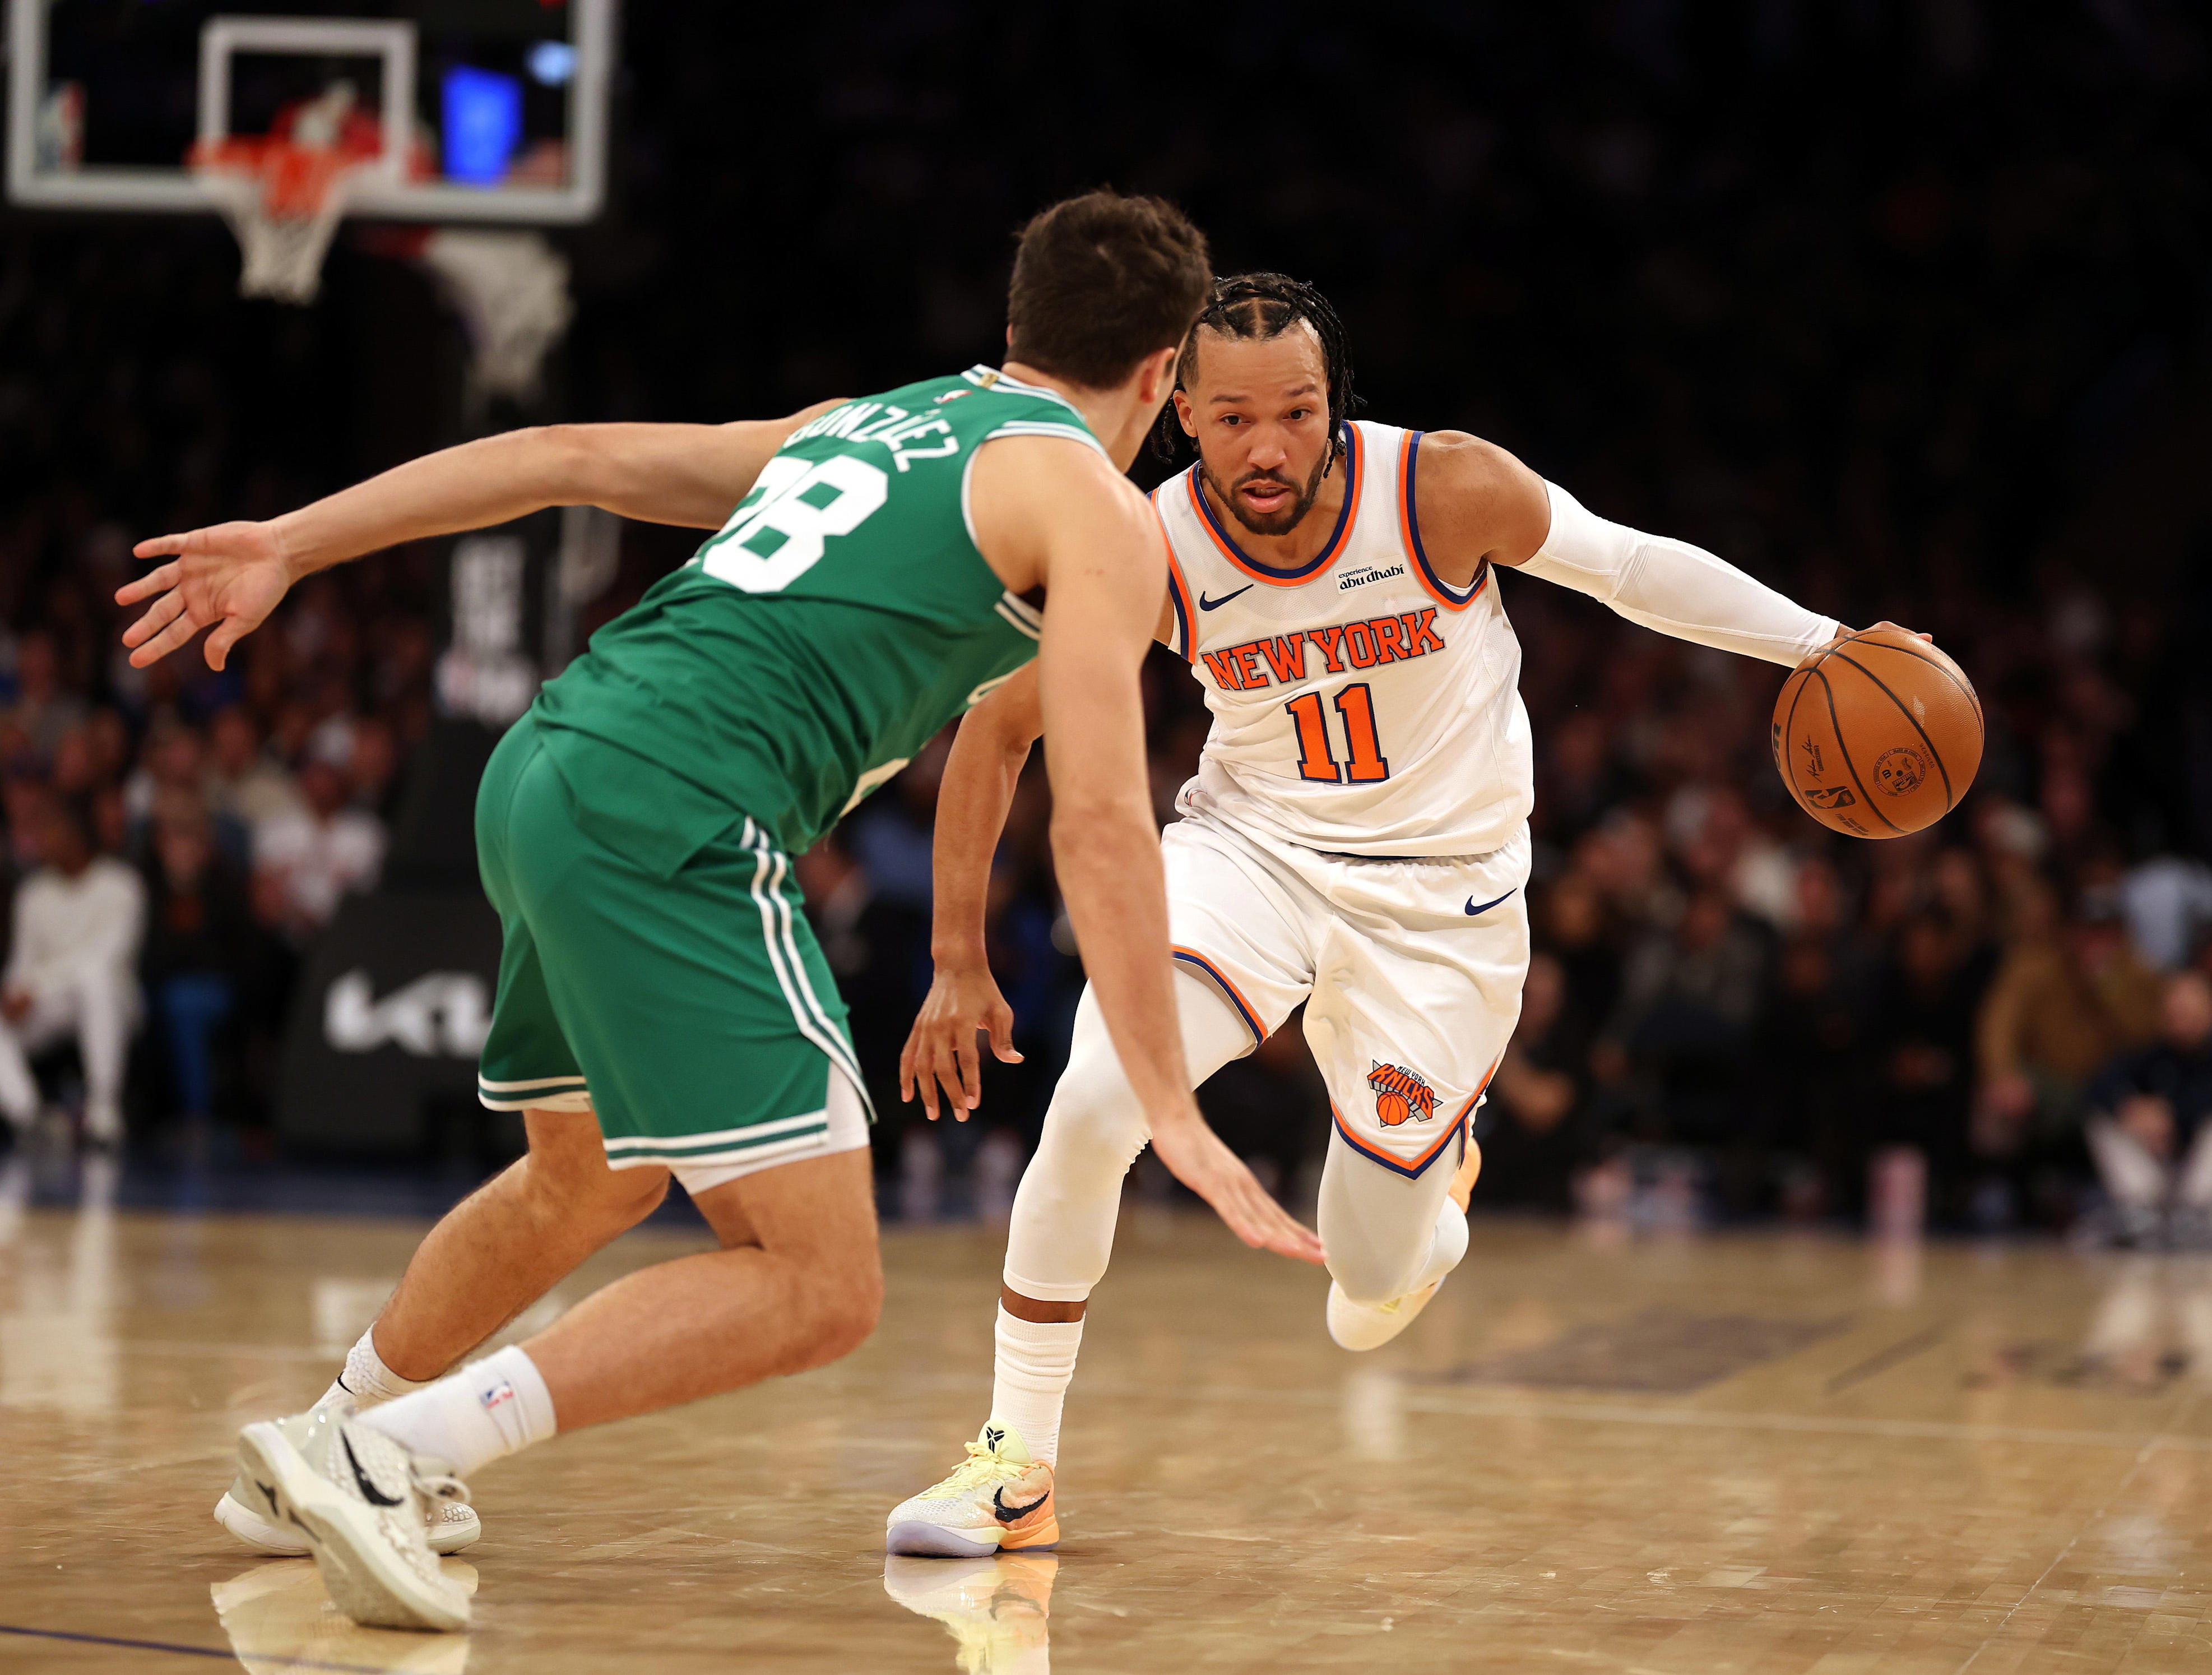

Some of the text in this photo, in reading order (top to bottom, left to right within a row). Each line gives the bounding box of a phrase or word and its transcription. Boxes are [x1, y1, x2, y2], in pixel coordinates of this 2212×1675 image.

[1338, 566, 1373, 579] experience
[1339, 564, 1405, 590] abu dhabi
[1201, 607, 1446, 692] NEW YORK
[1284, 682, 1390, 784] 11
[1366, 1063, 1435, 1119] KNICKS
[1396, 1066, 1426, 1086] NEW YORK
